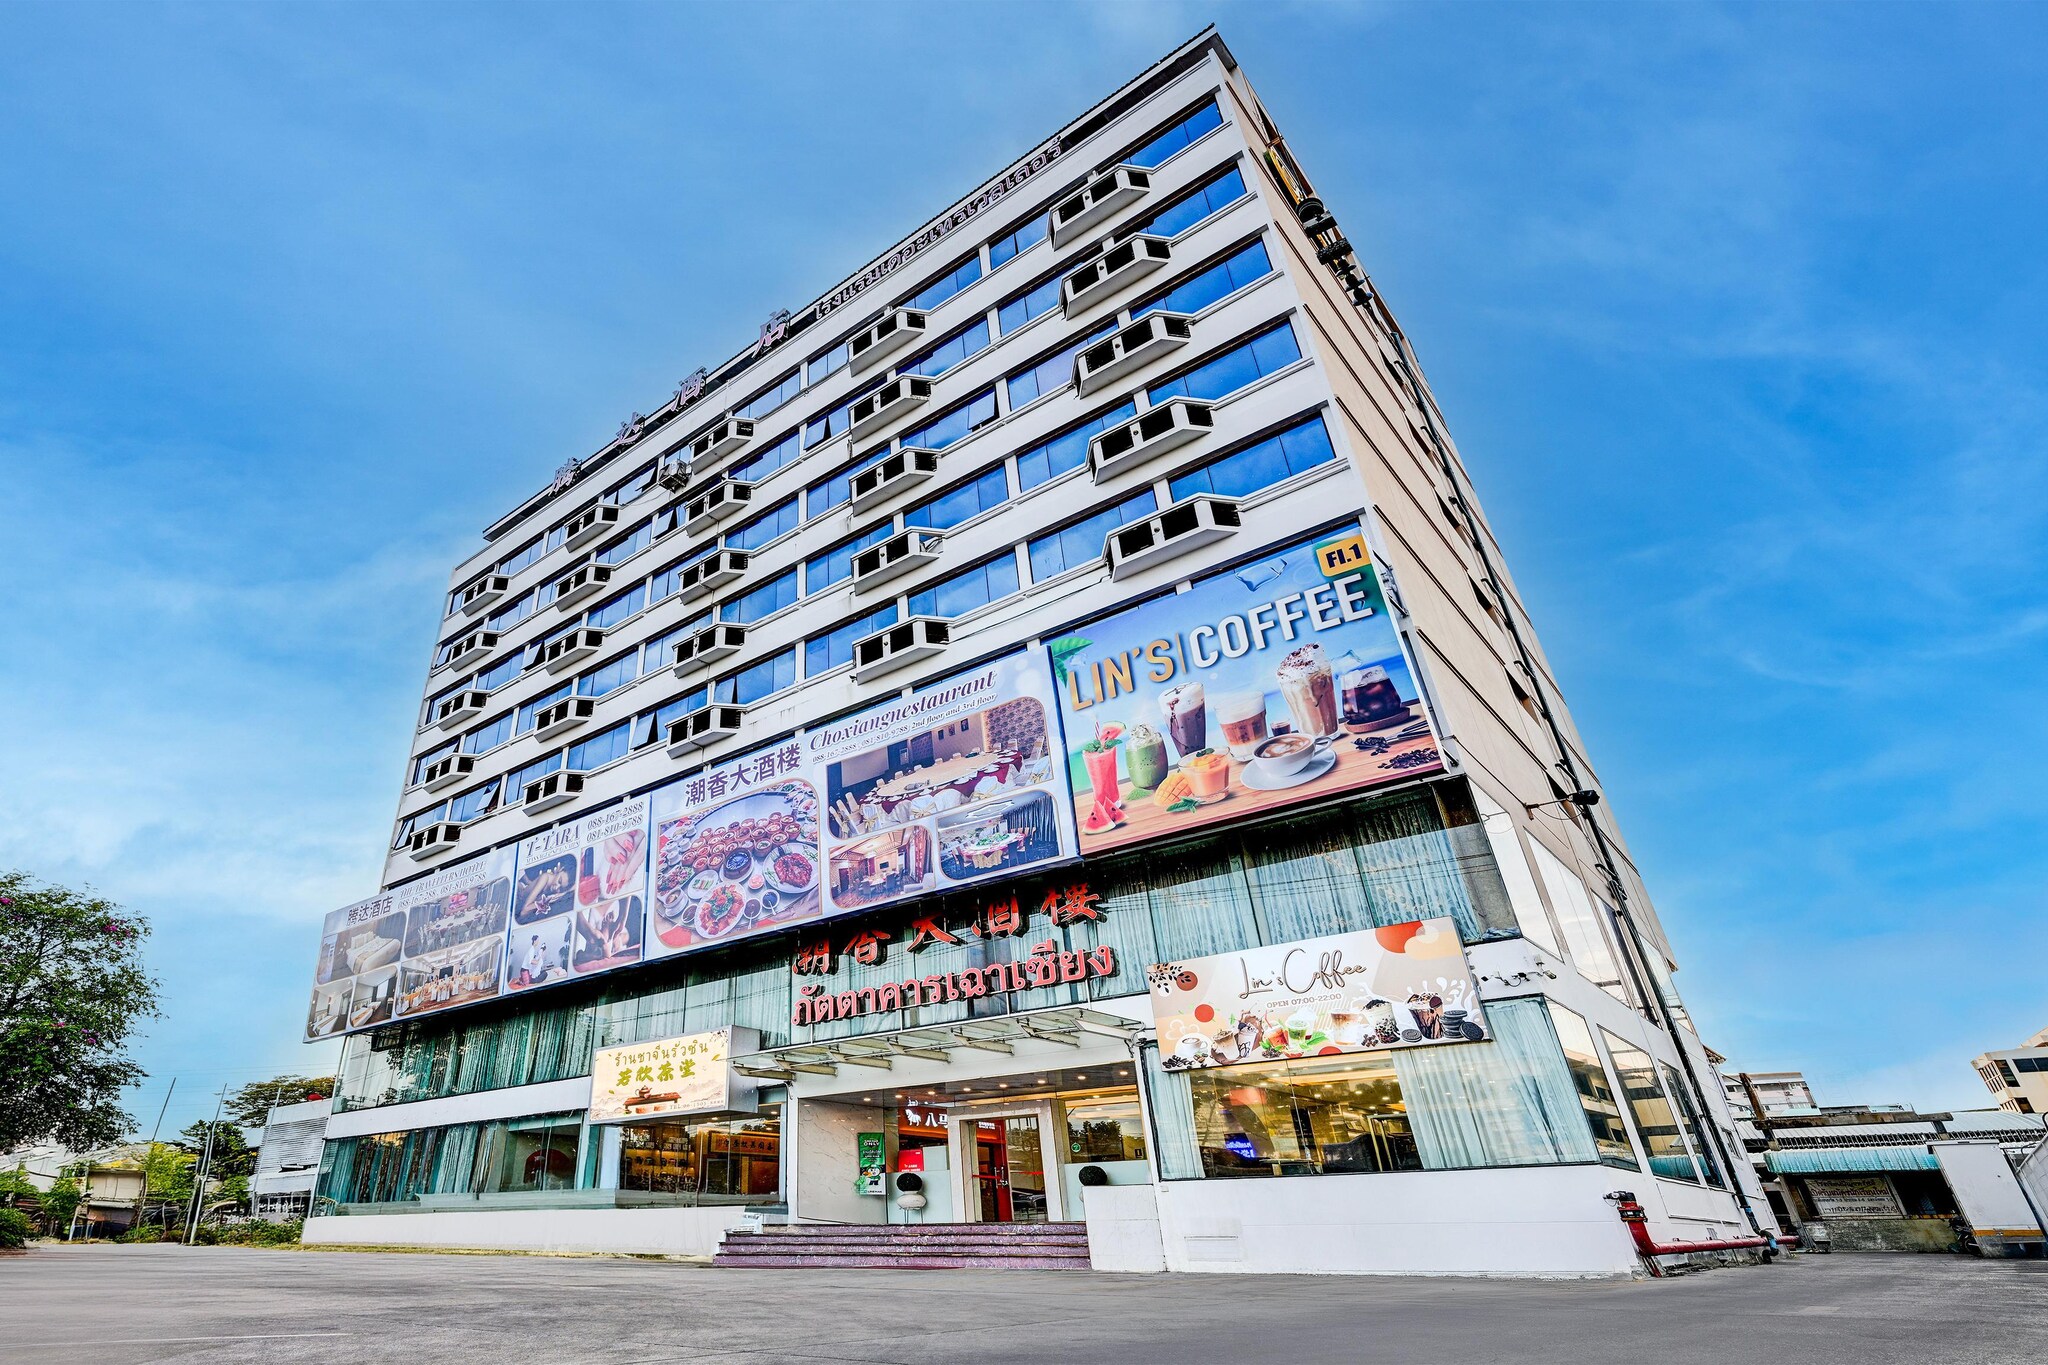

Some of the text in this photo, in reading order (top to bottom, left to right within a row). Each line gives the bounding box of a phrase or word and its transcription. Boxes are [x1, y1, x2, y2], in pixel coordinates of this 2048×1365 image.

[1188, 571, 1374, 669] COFFEE
[912, 718, 925, 730] 2nd
[925, 711, 945, 727] floor
[946, 704, 960, 718] and
[976, 693, 997, 709] floor
[685, 742, 802, 808] 潮香大酒楼
[347, 896, 393, 926] 腾达酒店
[1282, 948, 1367, 994] Coffee
[1267, 993, 1342, 1009] OPEN 07:00-22:00
